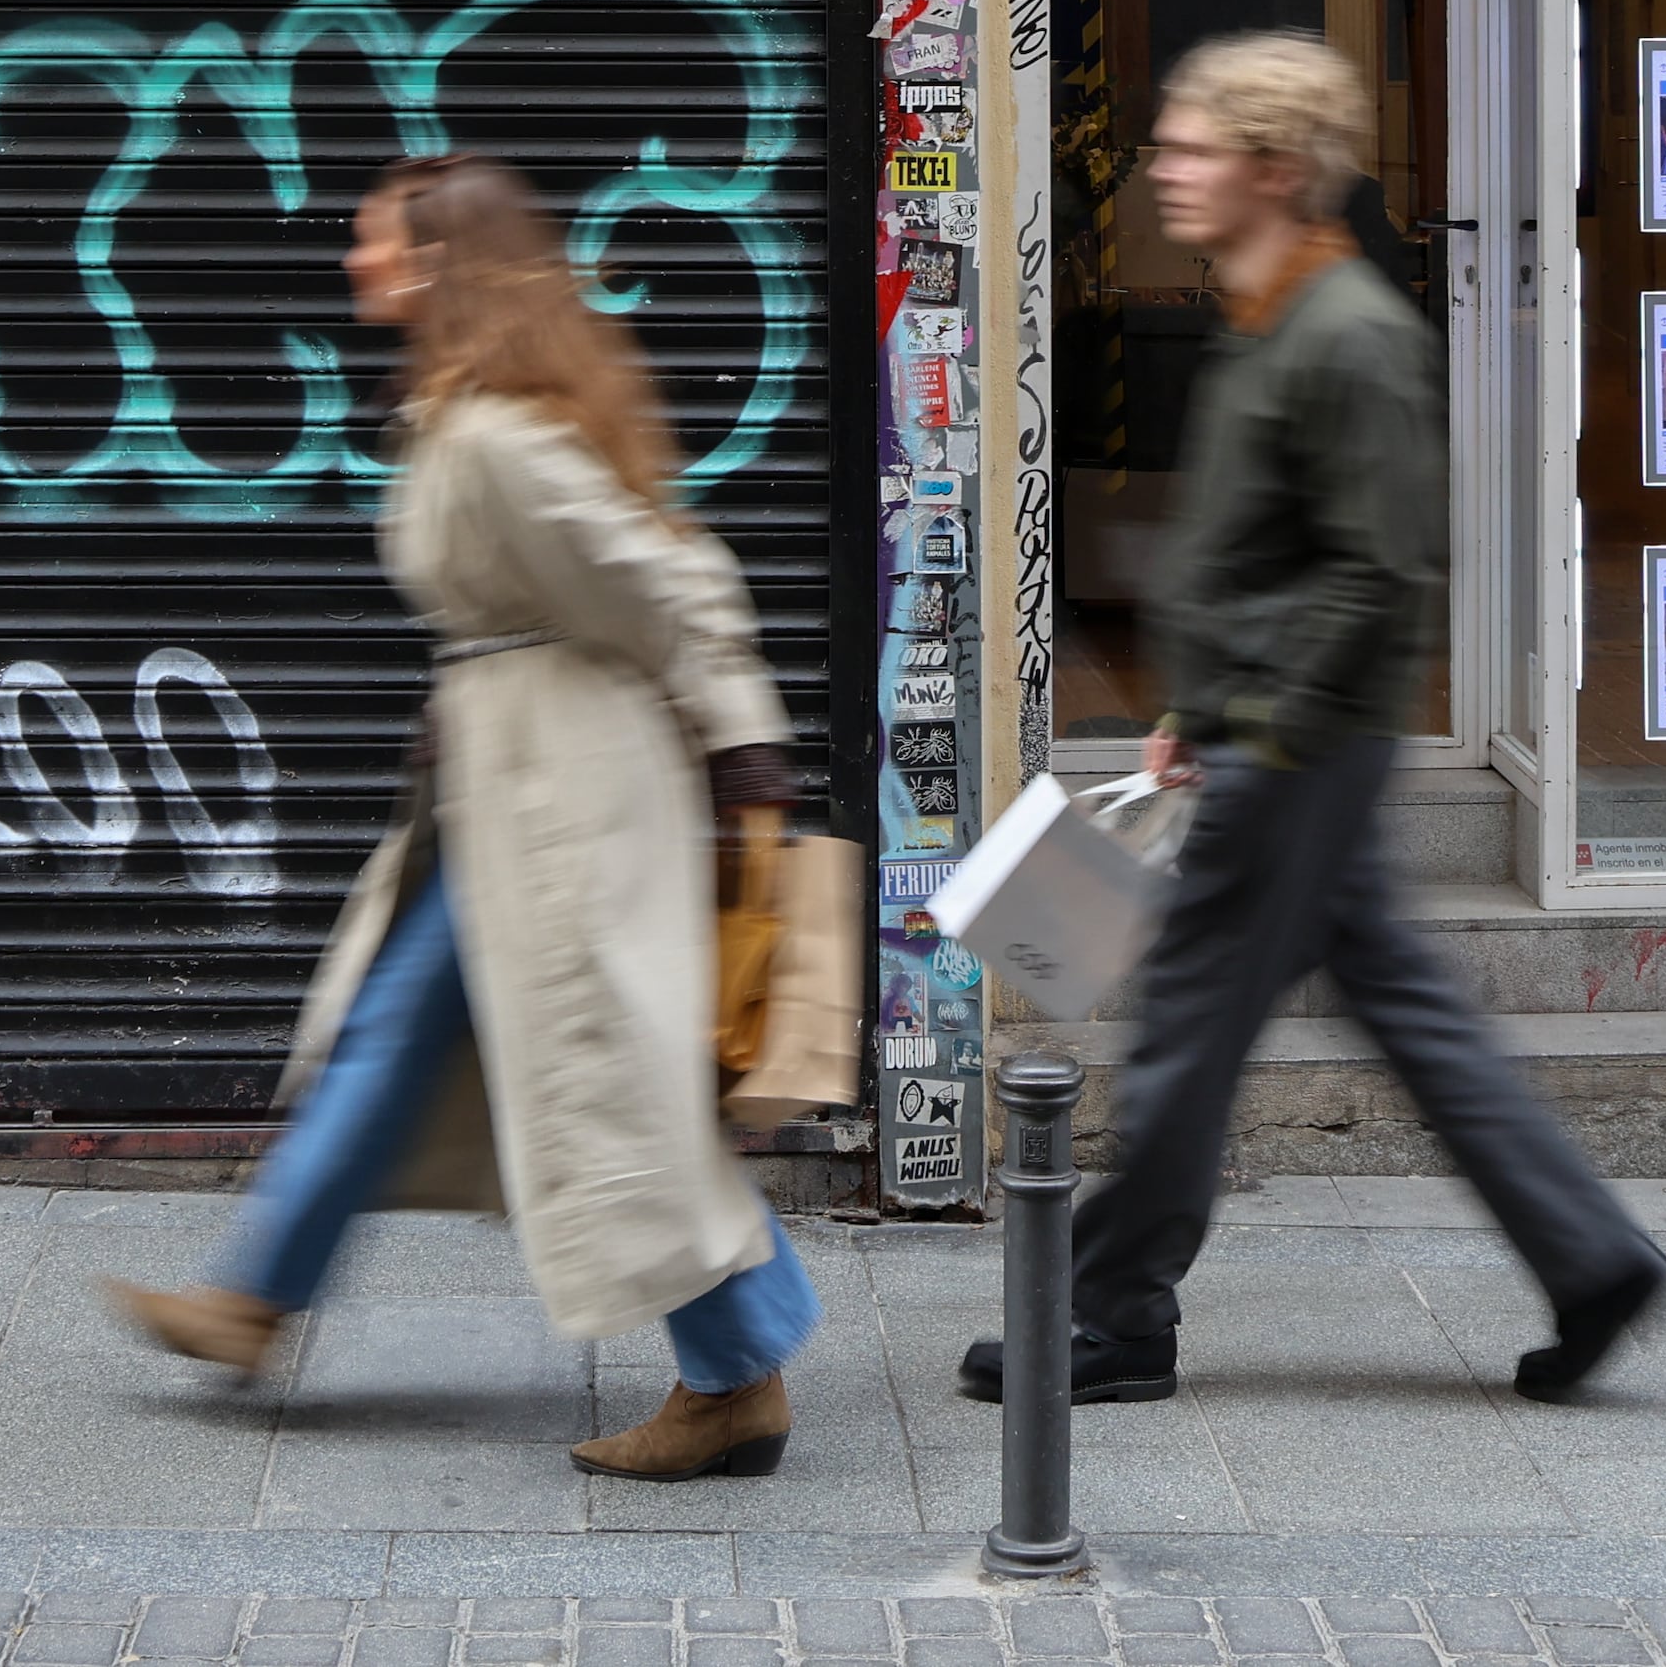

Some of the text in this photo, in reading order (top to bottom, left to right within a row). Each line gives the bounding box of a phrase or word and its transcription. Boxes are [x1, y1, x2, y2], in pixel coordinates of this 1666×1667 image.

[906, 44, 942, 62] FRAN
[895, 156, 951, 187] TEKI-1
[949, 224, 977, 236] BLUNT
[901, 647, 948, 667] OKO
[1595, 844, 1632, 855] Agente
[1598, 858, 1635, 868] inscrito
[1637, 859, 1651, 867] en
[1654, 858, 1664, 867] el
[902, 1137, 957, 1160] ANUS
